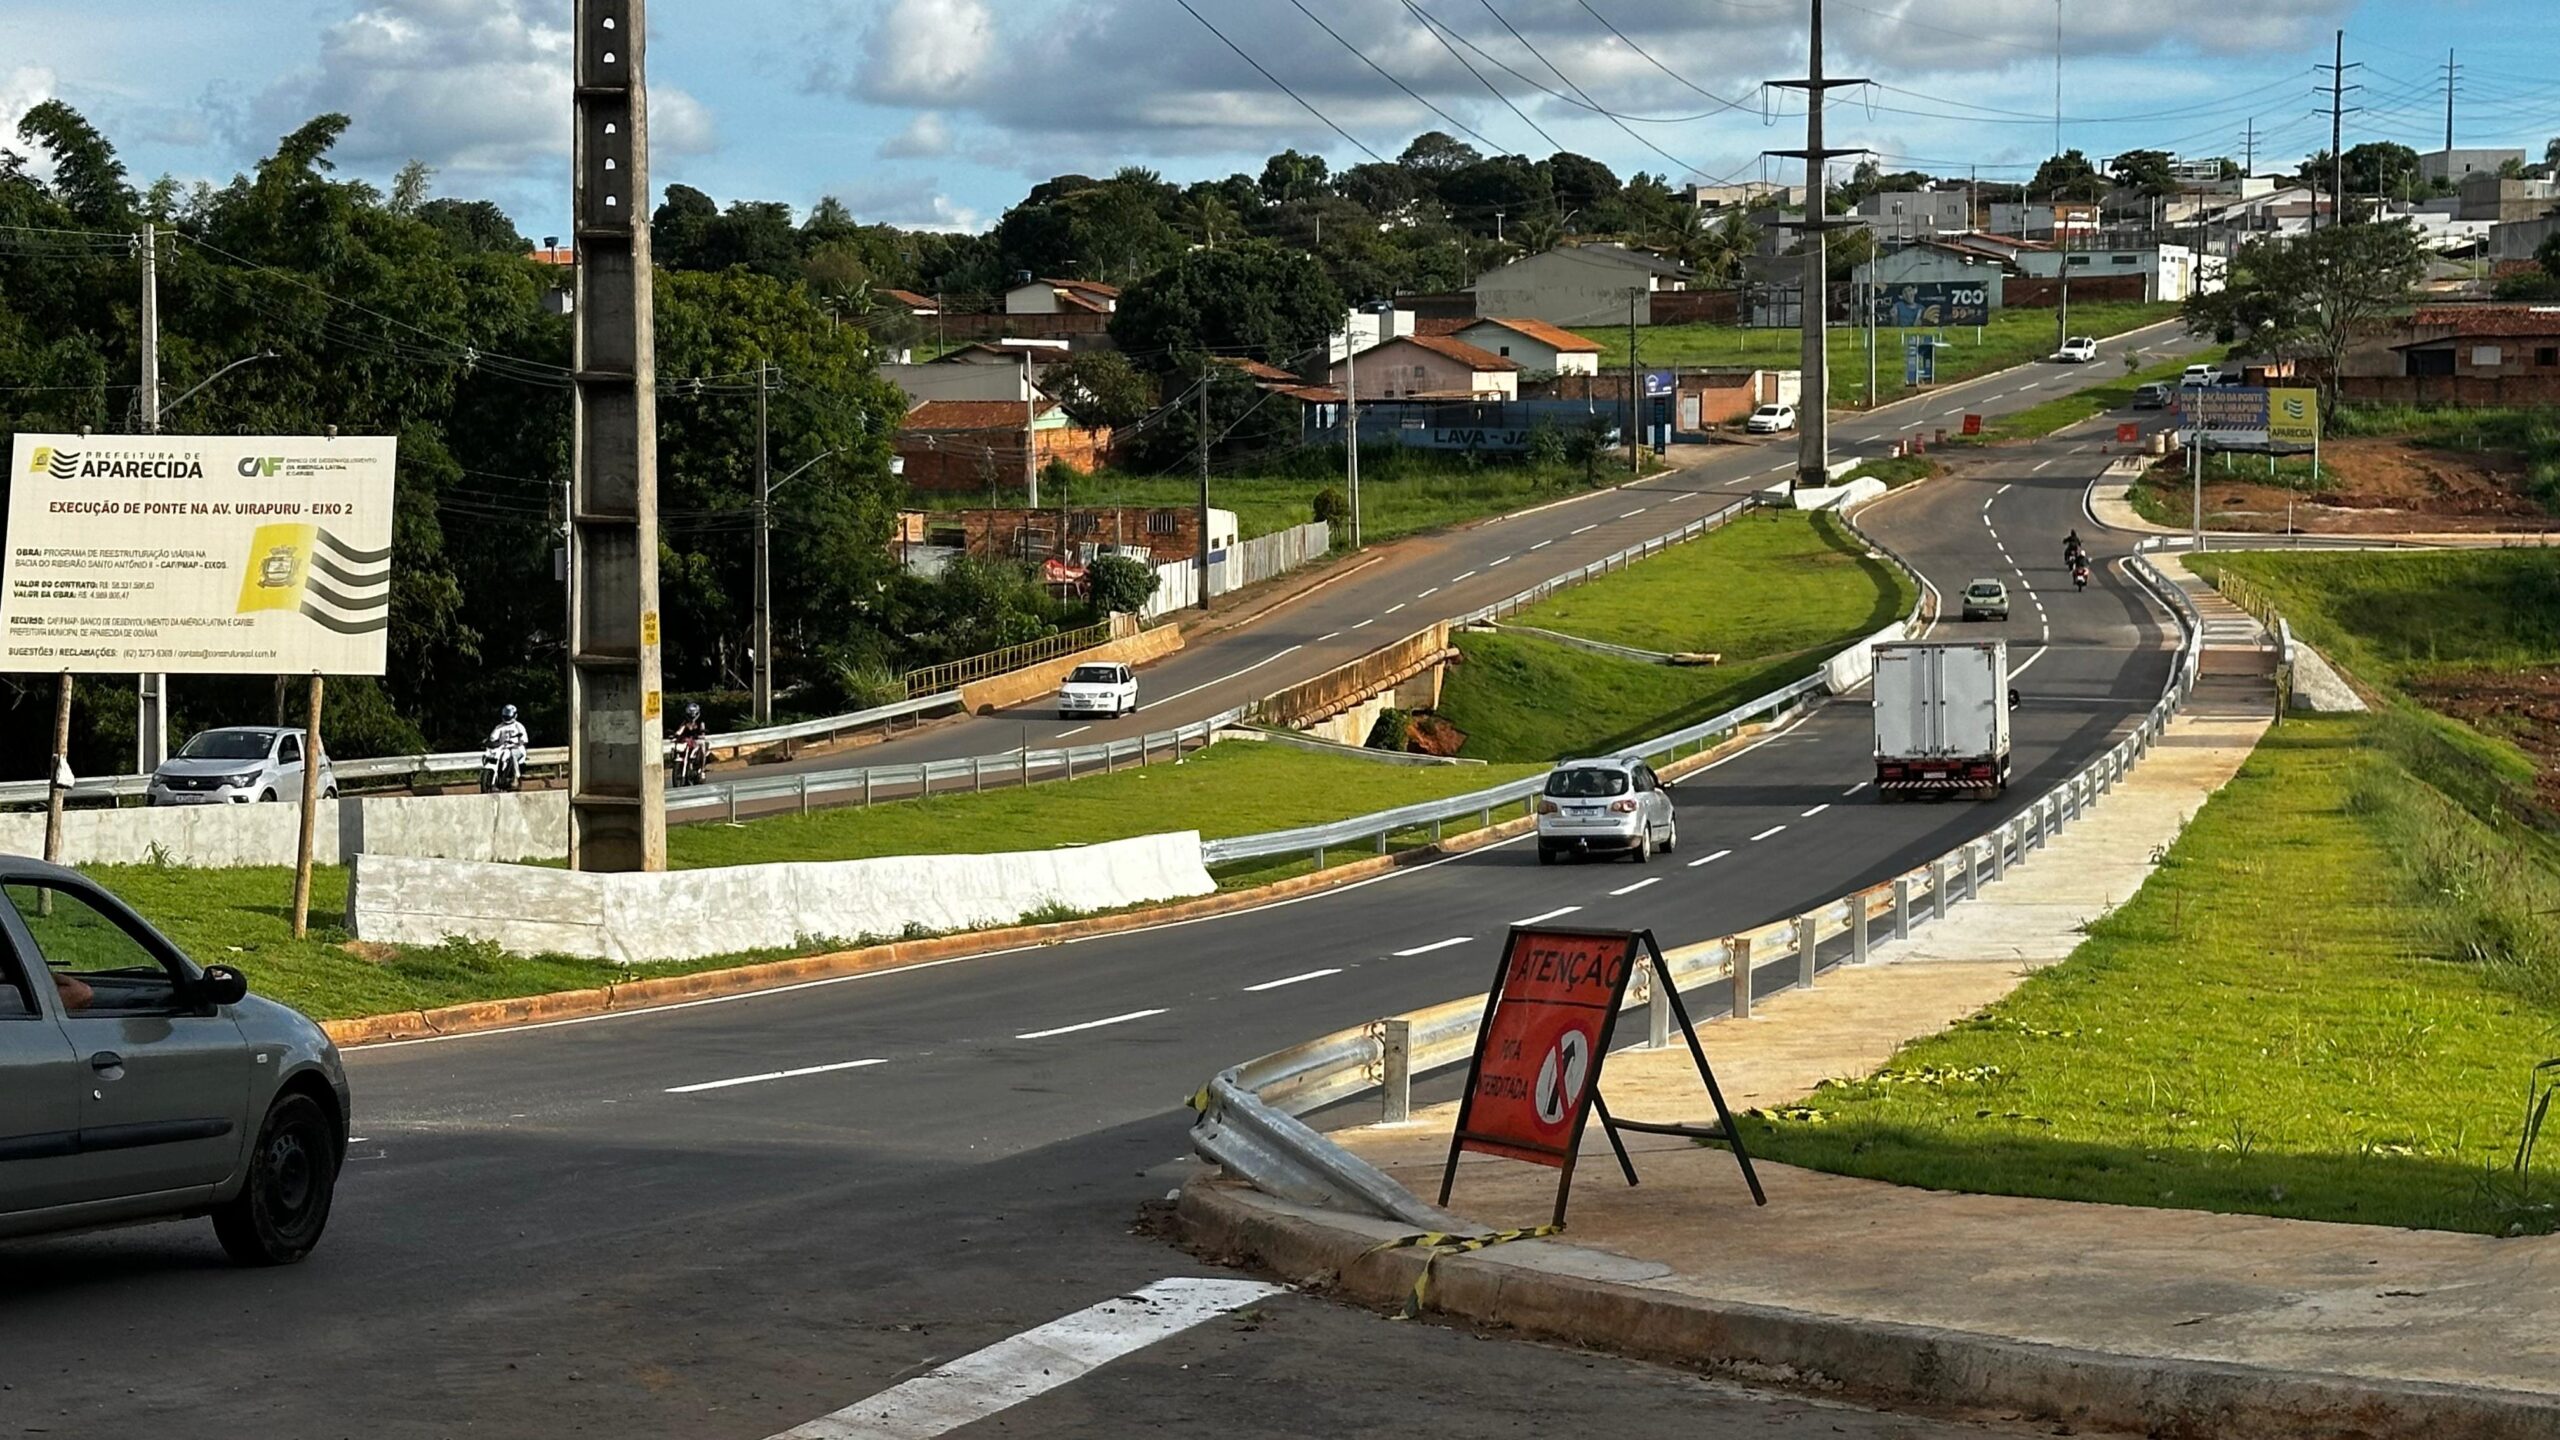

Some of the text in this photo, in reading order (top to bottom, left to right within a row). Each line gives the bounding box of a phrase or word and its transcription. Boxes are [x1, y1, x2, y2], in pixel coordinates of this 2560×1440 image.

[2181, 391, 2226, 402] DUPLCAÇÃO
[1433, 430, 1487, 444] LAVA
[2271, 429, 2313, 438] APARECIDA
[86, 451, 174, 459] PREFEITURA
[80, 460, 203, 478] APARECIDA
[237, 457, 285, 477] CAF
[49, 500, 120, 516] EXECUÇÃO
[123, 502, 141, 514] DE
[144, 502, 187, 515] PONTE
[190, 503, 209, 515] NA
[212, 503, 231, 515] AV.
[235, 503, 300, 515] UIRAPURU
[312, 503, 342, 515] EIXO
[345, 503, 353, 515] 2
[16, 548, 42, 556] OBRA:
[43, 549, 86, 557] PROGRAMA
[87, 549, 98, 557] DE
[99, 549, 170, 560] REESTRUTURAÇÃO
[196, 550, 206, 558] NA
[88, 560, 113, 568] SANTO
[14, 580, 40, 588] VALOR
[41, 580, 52, 588] DO
[54, 580, 98, 588] CONTRATO:
[10, 616, 45, 625] RECURSO:
[80, 617, 102, 626] BANCO
[102, 618, 111, 626] DE
[123, 629, 132, 637] DE
[8, 646, 54, 656] SUGESTÕES
[59, 647, 118, 658] RECLAMAÇÕES:
[1516, 945, 1623, 993] ATENÇÃO
